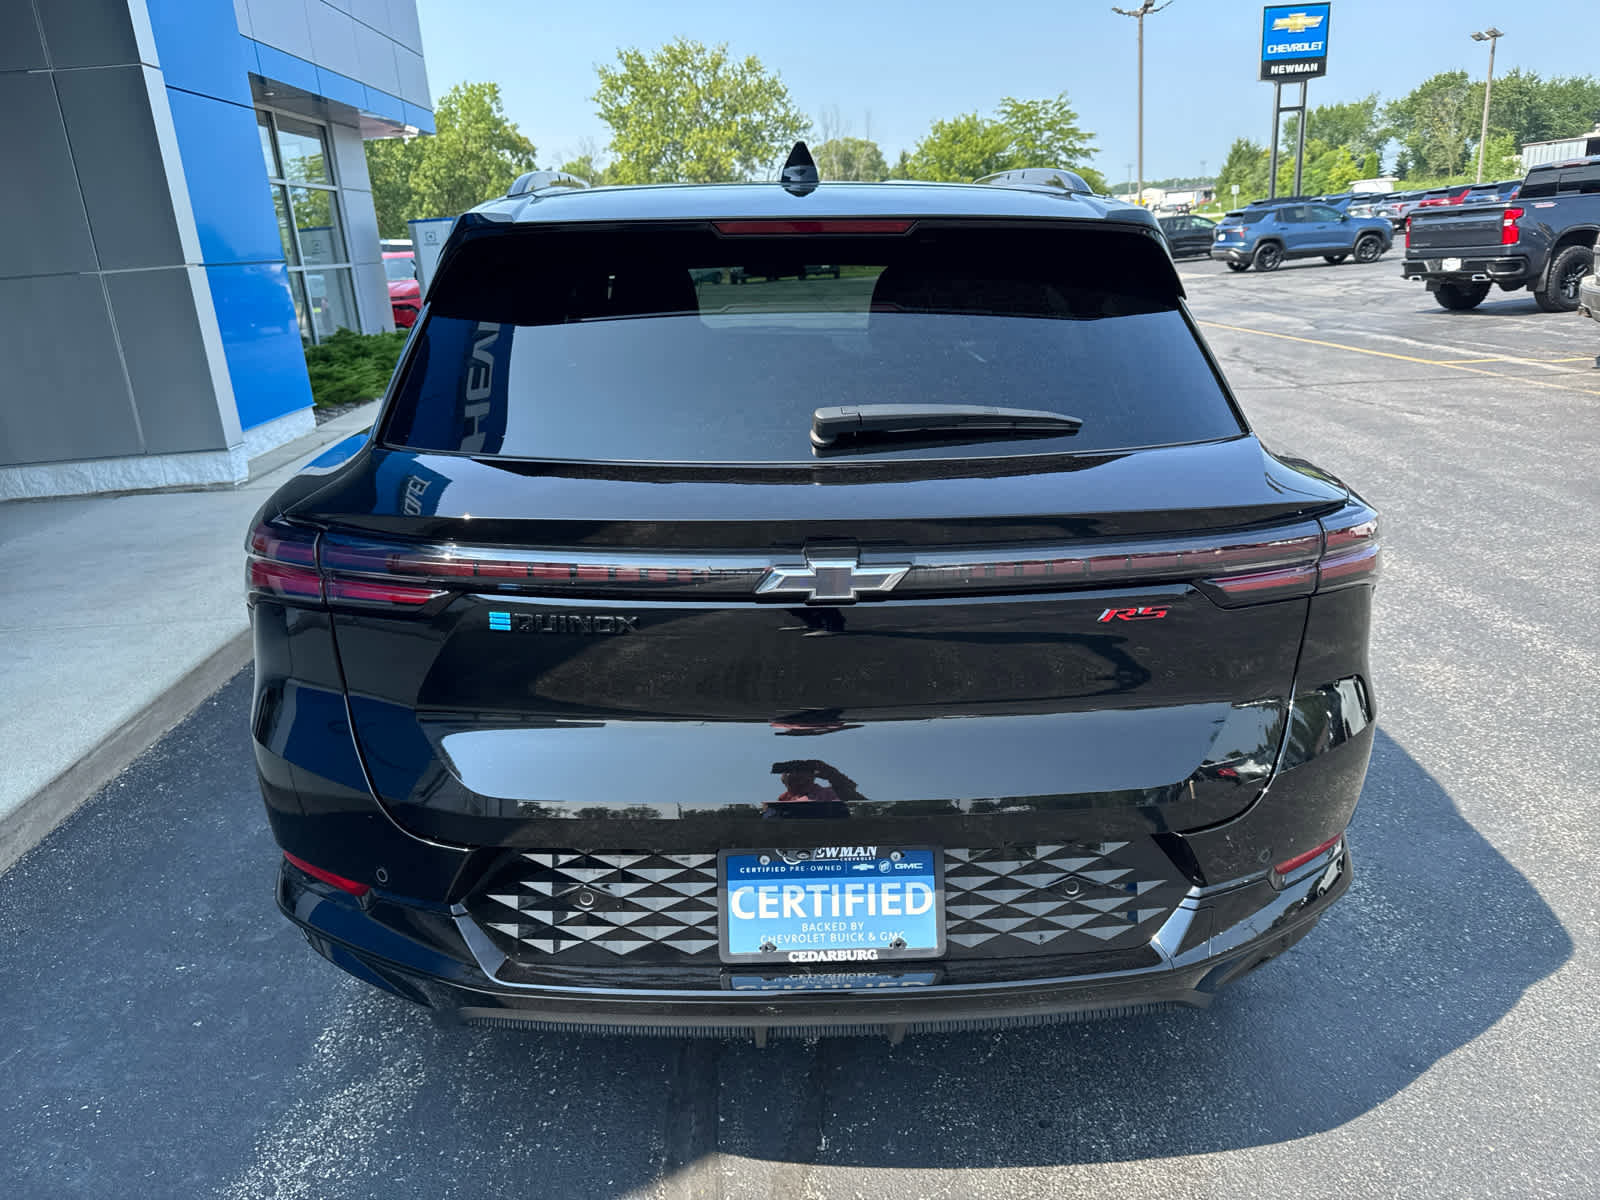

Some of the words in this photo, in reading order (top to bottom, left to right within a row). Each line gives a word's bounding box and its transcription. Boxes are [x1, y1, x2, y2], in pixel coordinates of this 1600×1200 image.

[1267, 41, 1324, 54] CHEVROLET
[1270, 63, 1318, 75] NEWMAN
[1097, 605, 1172, 622] RS
[789, 864, 842, 872] PRE-OWNED
[894, 862, 924, 870] GMC
[731, 881, 933, 920] CERTIFIED
[801, 922, 847, 933] BACKED
[850, 921, 865, 931] BY
[760, 932, 826, 945] CHEVROLET
[830, 931, 865, 943] BUICK
[868, 931, 876, 941] &
[788, 949, 878, 963] CEDARBURG
